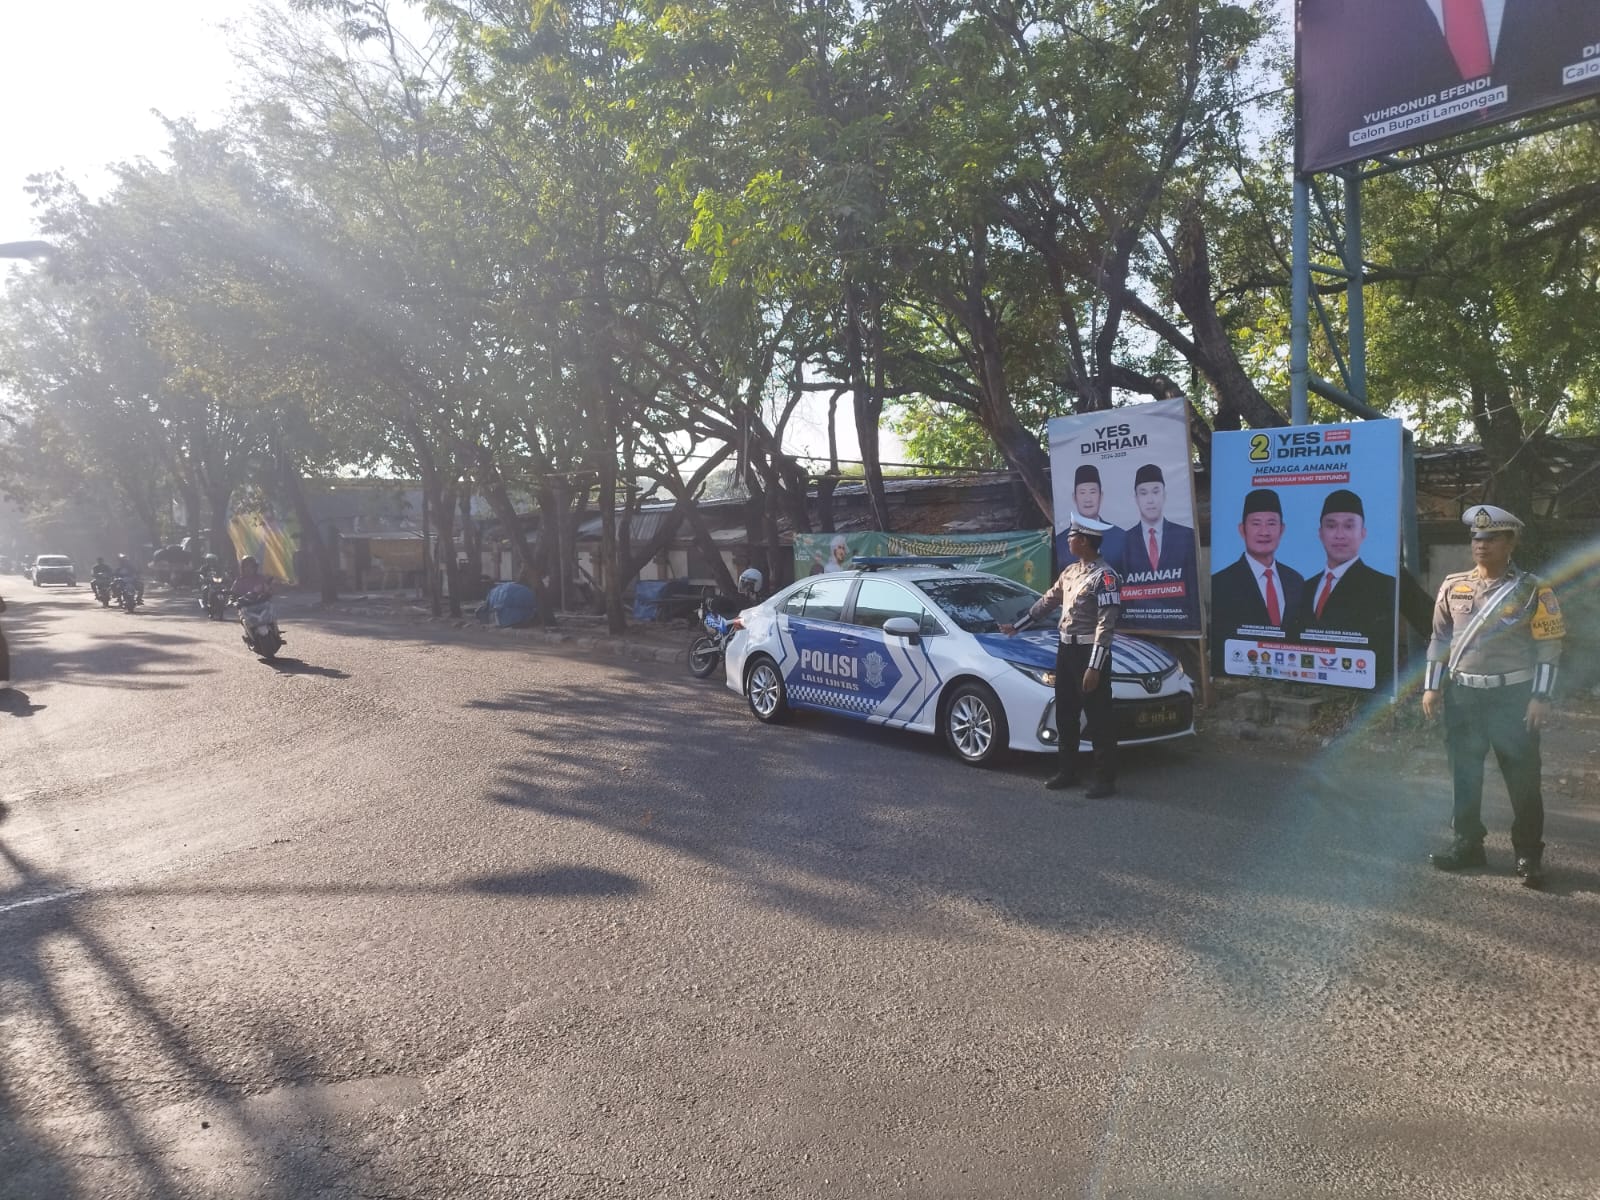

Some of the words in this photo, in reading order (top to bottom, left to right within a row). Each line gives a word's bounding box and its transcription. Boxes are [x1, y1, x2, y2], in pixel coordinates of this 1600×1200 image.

[1363, 94, 1437, 124] YUHRONUR
[1440, 76, 1491, 101] EFENDI
[1352, 126, 1385, 142] Calon
[1389, 110, 1430, 132] Bupati
[1433, 90, 1505, 119] Lamongan
[1094, 423, 1131, 440] YES
[1278, 431, 1321, 446] YES
[1080, 434, 1148, 454] DIRHAM
[1250, 433, 1270, 461] 2
[1277, 444, 1351, 458] DIRHAM
[1255, 465, 1300, 474] MENJAGA
[1302, 462, 1348, 473] AMANAH
[1126, 567, 1182, 583] AMANAH
[1144, 585, 1183, 596] TERTUNDA
[801, 648, 858, 679] POLISI
[801, 673, 823, 684] LALU
[825, 678, 860, 691] LINTAS
